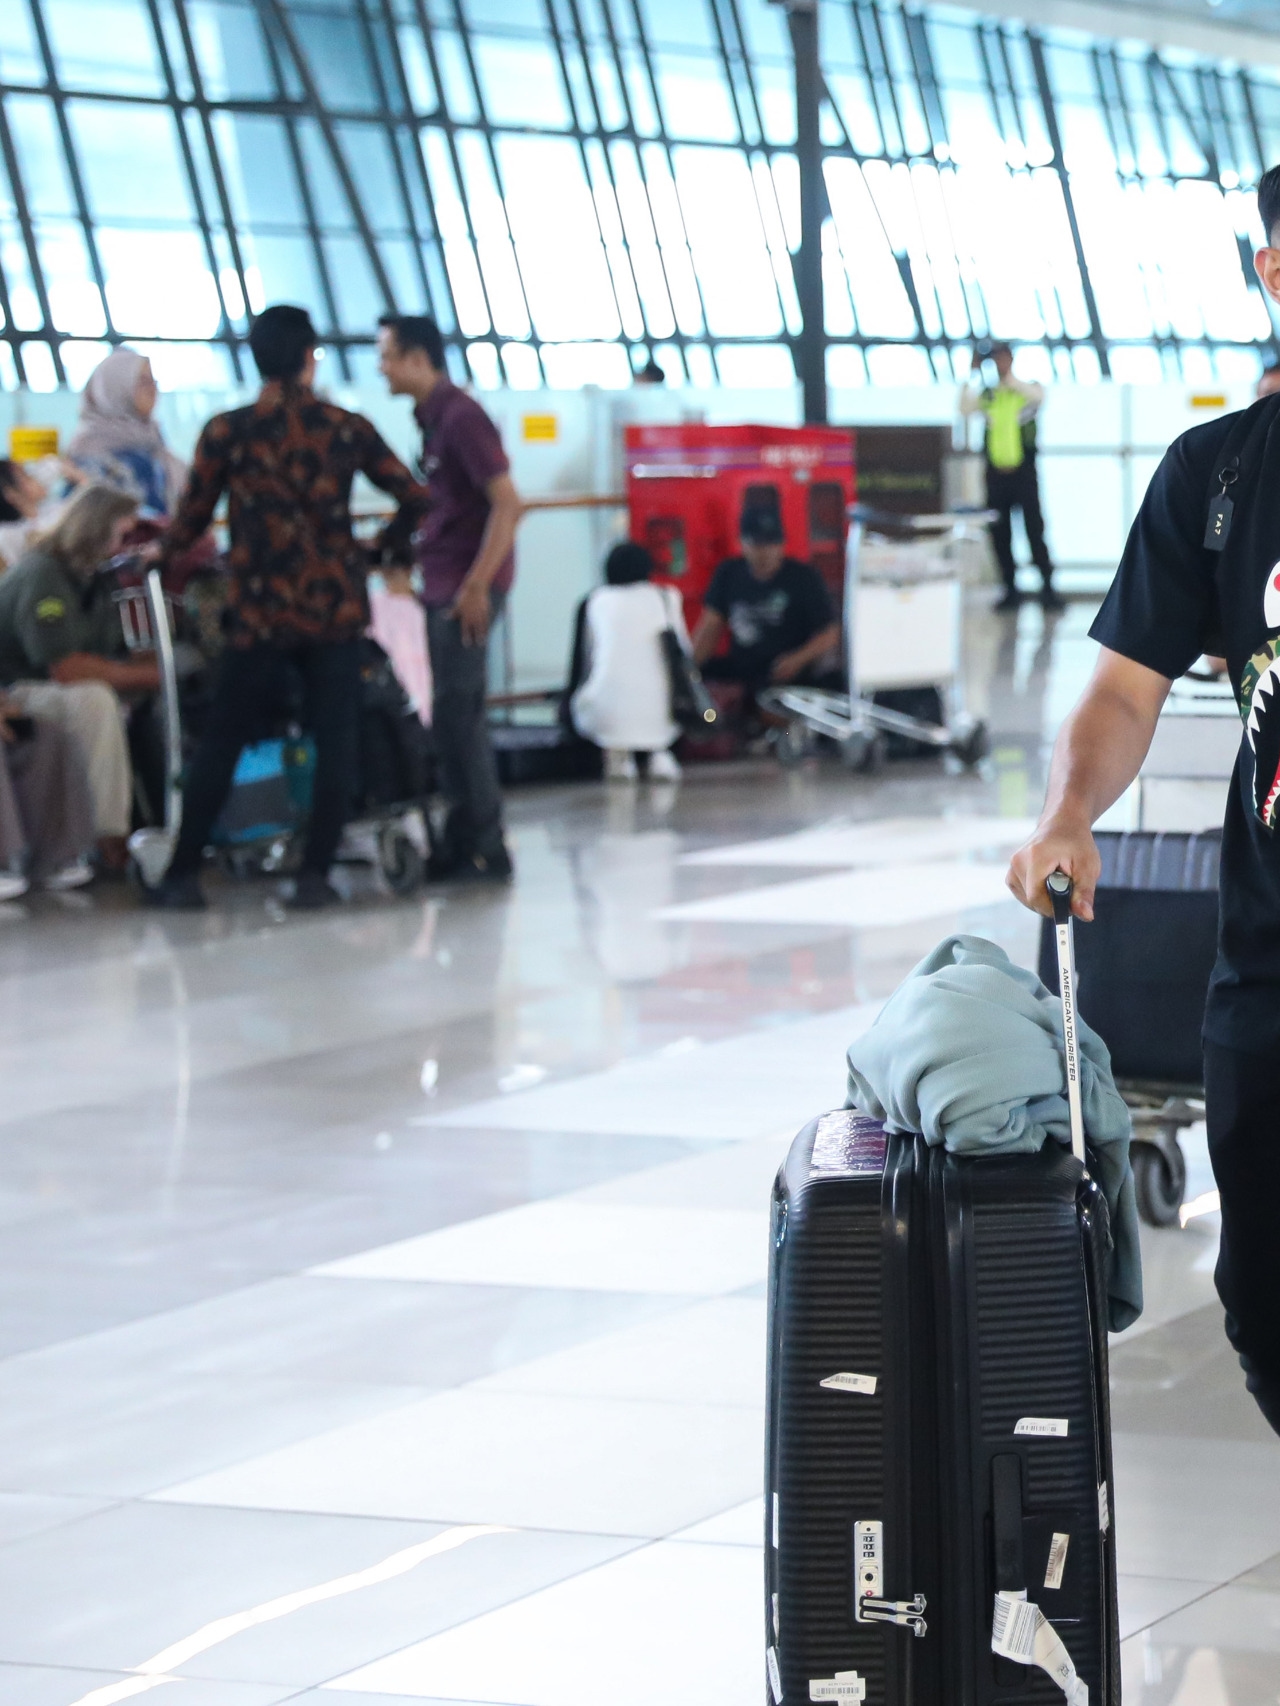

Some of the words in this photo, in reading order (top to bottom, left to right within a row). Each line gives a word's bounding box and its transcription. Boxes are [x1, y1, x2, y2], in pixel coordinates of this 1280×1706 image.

[1214, 513, 1224, 536] FA7
[1062, 967, 1072, 1024] AMERICAN
[1065, 1025, 1076, 1082] TOURISTER
